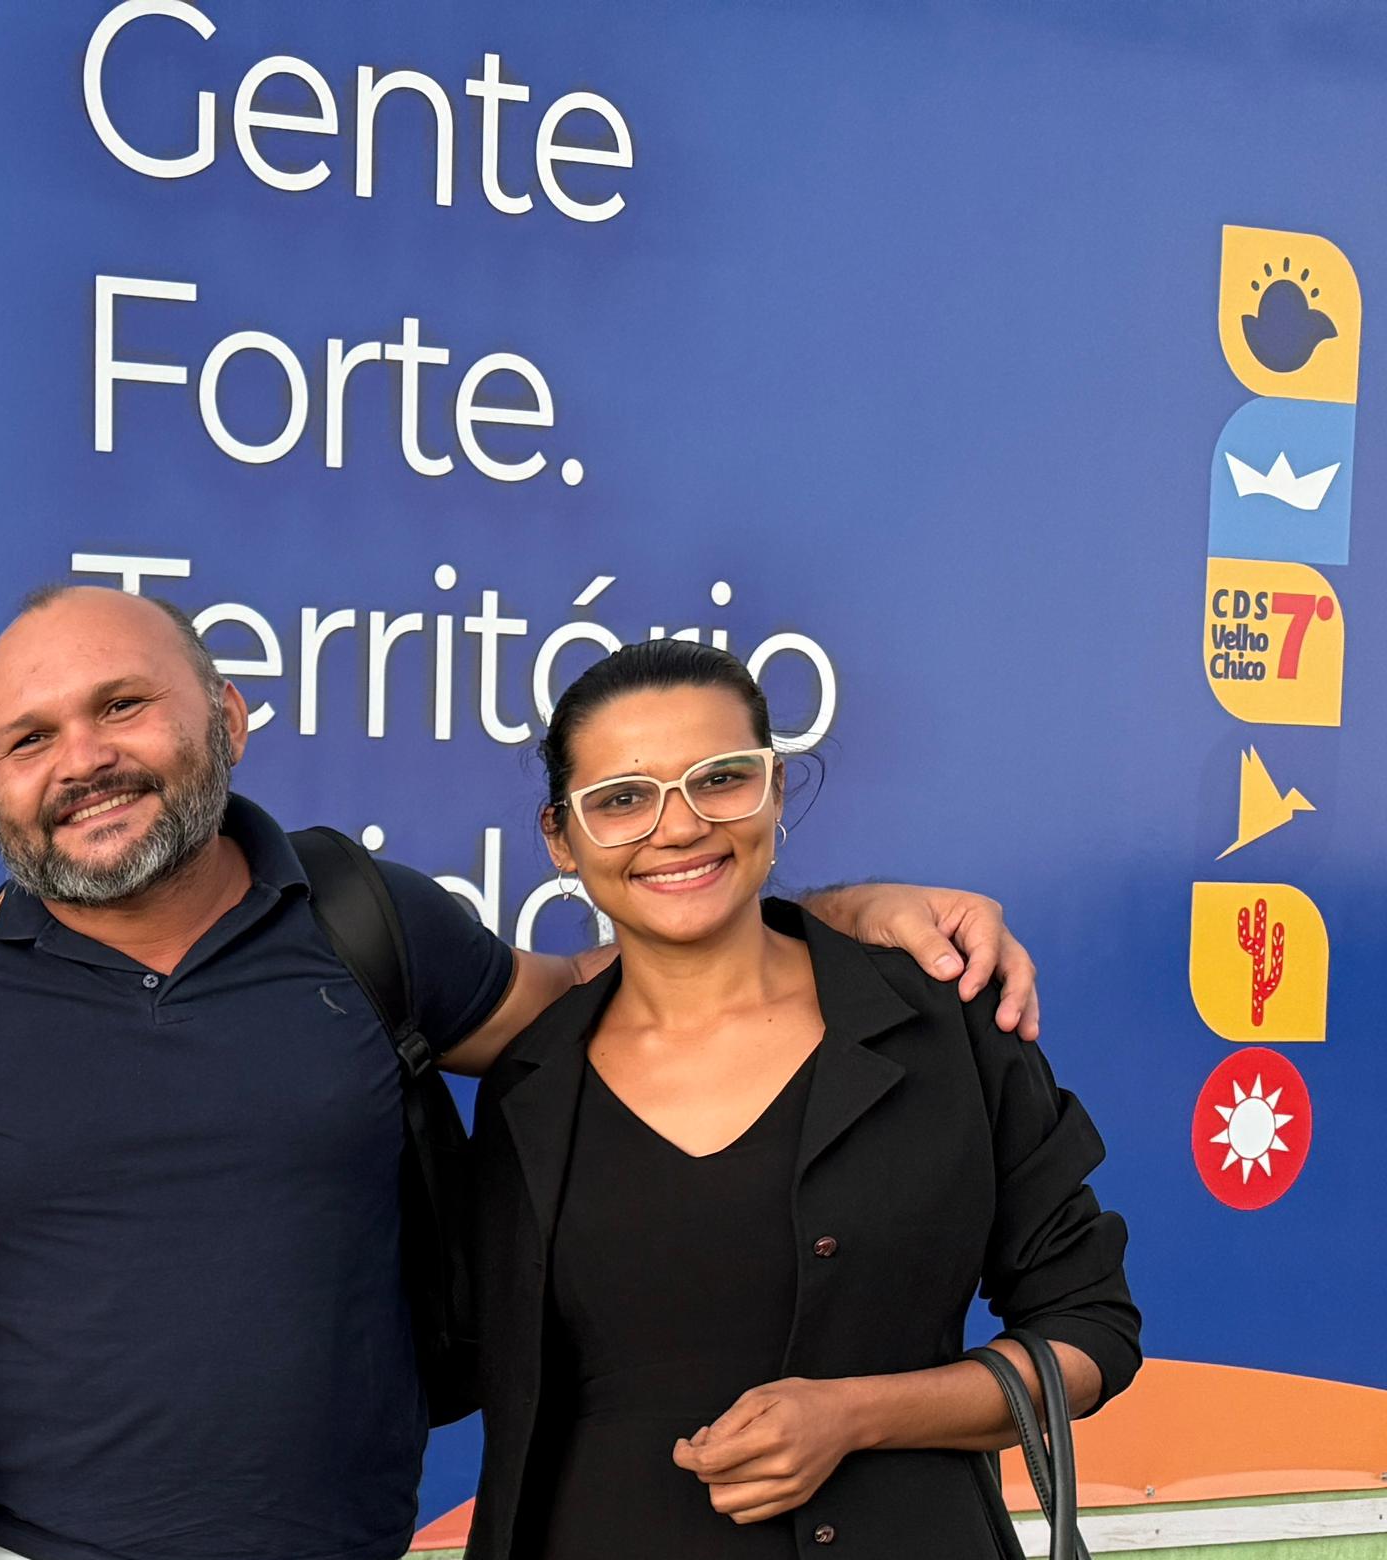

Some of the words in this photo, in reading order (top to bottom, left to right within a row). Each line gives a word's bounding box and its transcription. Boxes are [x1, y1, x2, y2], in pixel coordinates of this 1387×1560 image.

[83, 0, 634, 223] Gente
[94, 274, 584, 487] Forte.
[71, 554, 836, 753] erritóo
[1211, 623, 1269, 652] Velho
[1212, 588, 1269, 621] CDS
[1209, 651, 1266, 681] Chico
